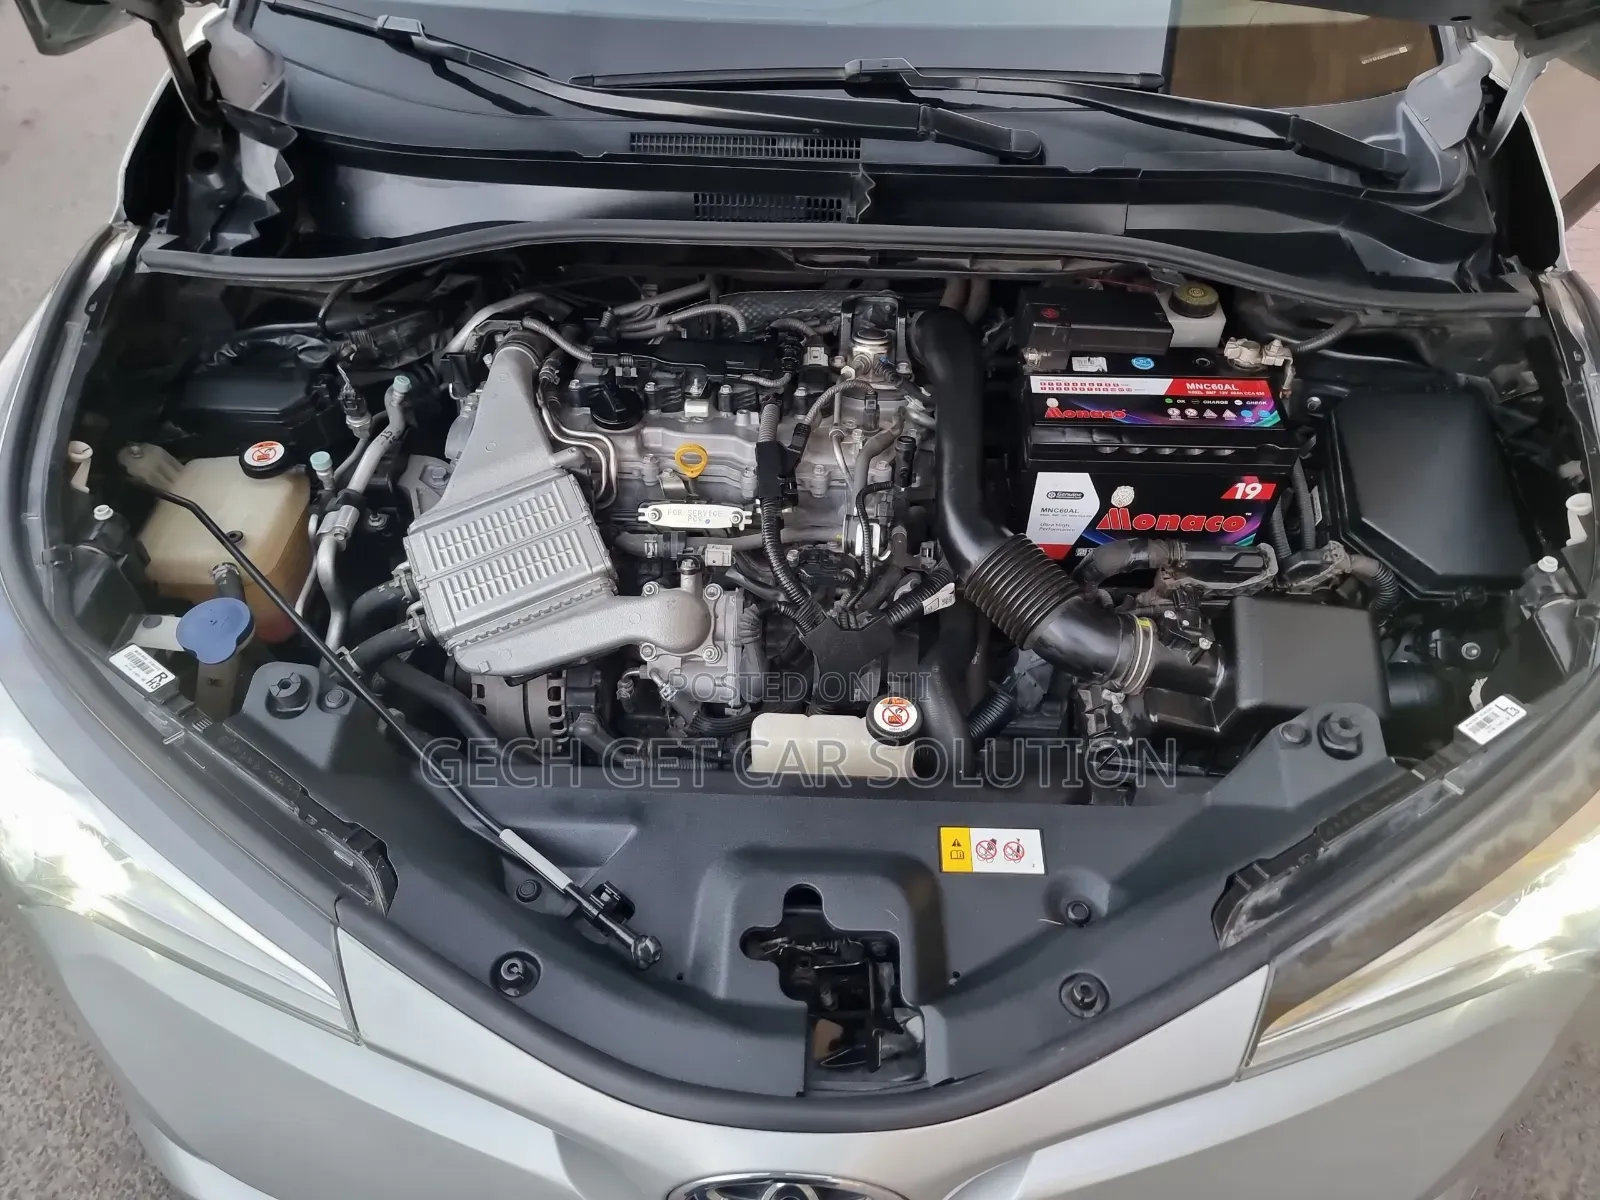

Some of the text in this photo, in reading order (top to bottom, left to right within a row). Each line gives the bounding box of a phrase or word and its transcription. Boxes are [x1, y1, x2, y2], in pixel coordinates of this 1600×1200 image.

[1186, 383, 1239, 391] MNC60AL
[1045, 407, 1126, 418] Monaco
[1234, 482, 1263, 500] 19
[667, 508, 723, 518] FOR SERVICE
[1095, 507, 1247, 533] Monaco
